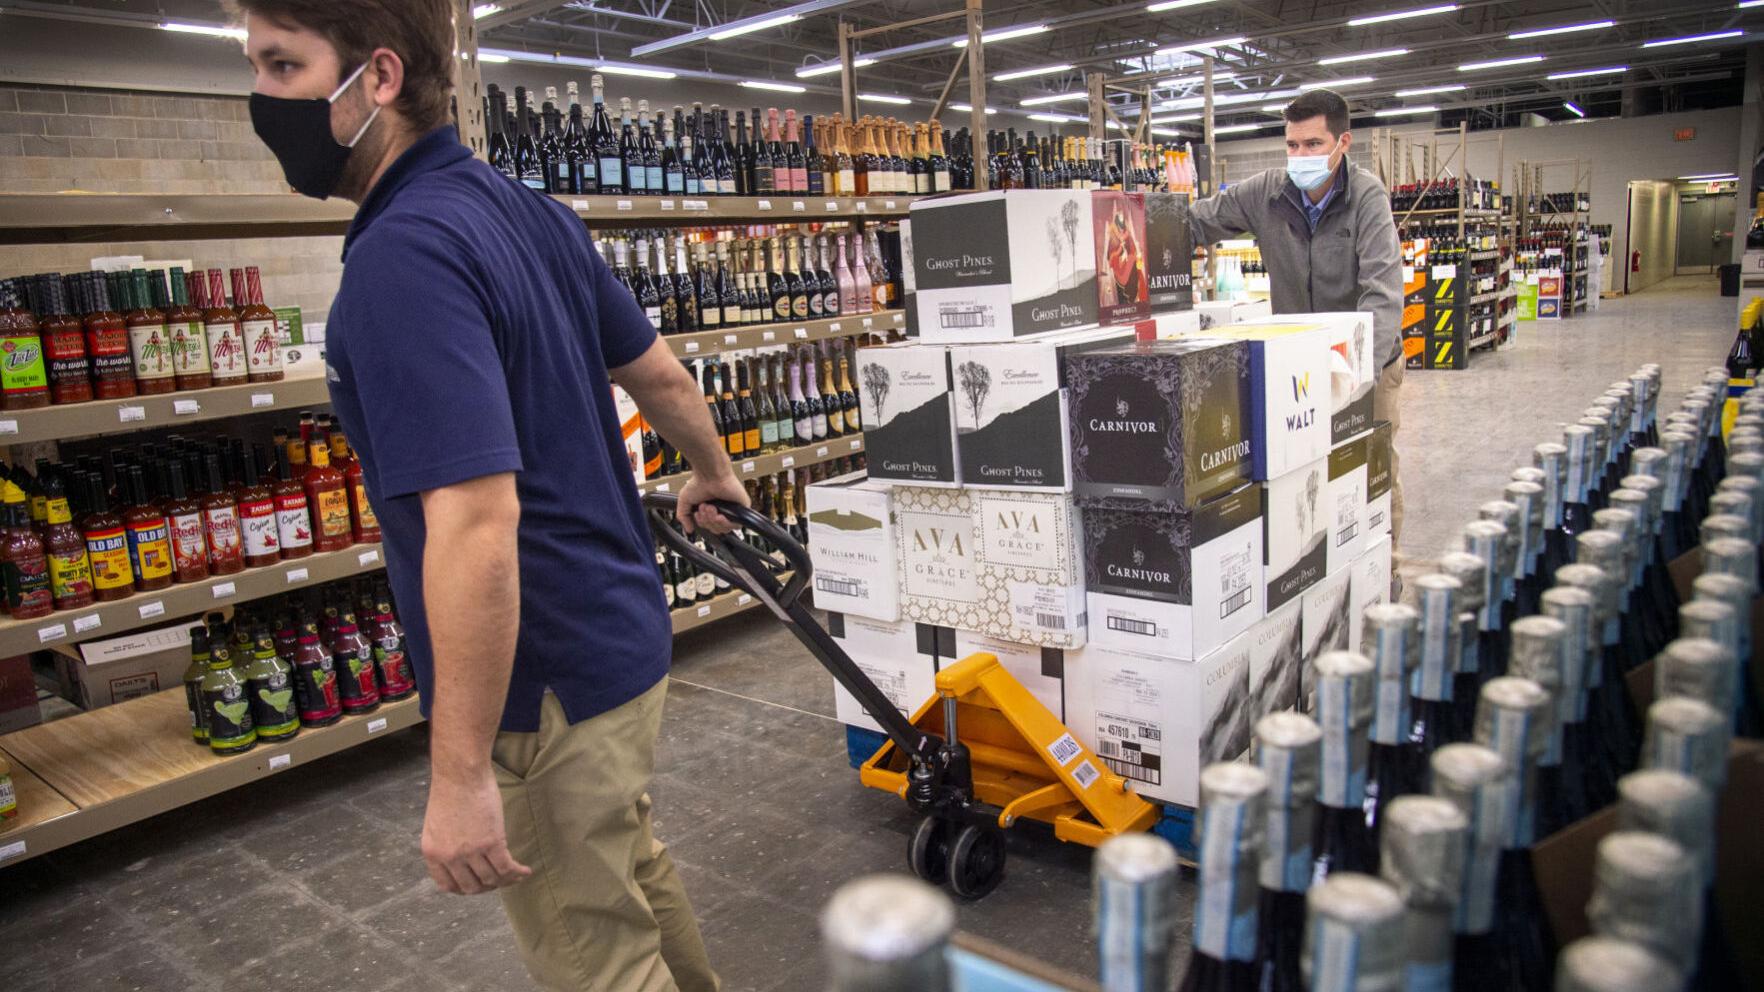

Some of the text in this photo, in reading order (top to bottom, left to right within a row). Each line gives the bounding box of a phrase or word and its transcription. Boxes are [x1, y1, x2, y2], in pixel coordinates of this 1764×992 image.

[926, 254, 993, 270] GHOST PINES
[1150, 274, 1191, 288] ARNIVOR
[1031, 304, 1082, 322] GHOST PINES
[1089, 418, 1157, 434] CARNIVOR
[1286, 408, 1315, 432] WALT
[1200, 440, 1250, 472] CARNIVOR
[883, 460, 937, 473] GHOST PINES
[980, 465, 1043, 477] GHOST PINES
[997, 511, 1040, 533] AVA
[88, 537, 123, 551] OLD BAY
[138, 531, 157, 542] OLD
[913, 527, 965, 557] AVA
[998, 539, 1042, 551] GRACE
[820, 547, 855, 559] WILLIAM
[858, 553, 877, 563] HILL
[915, 564, 966, 579] GRACE
[1107, 564, 1171, 583] CARNIVOR
